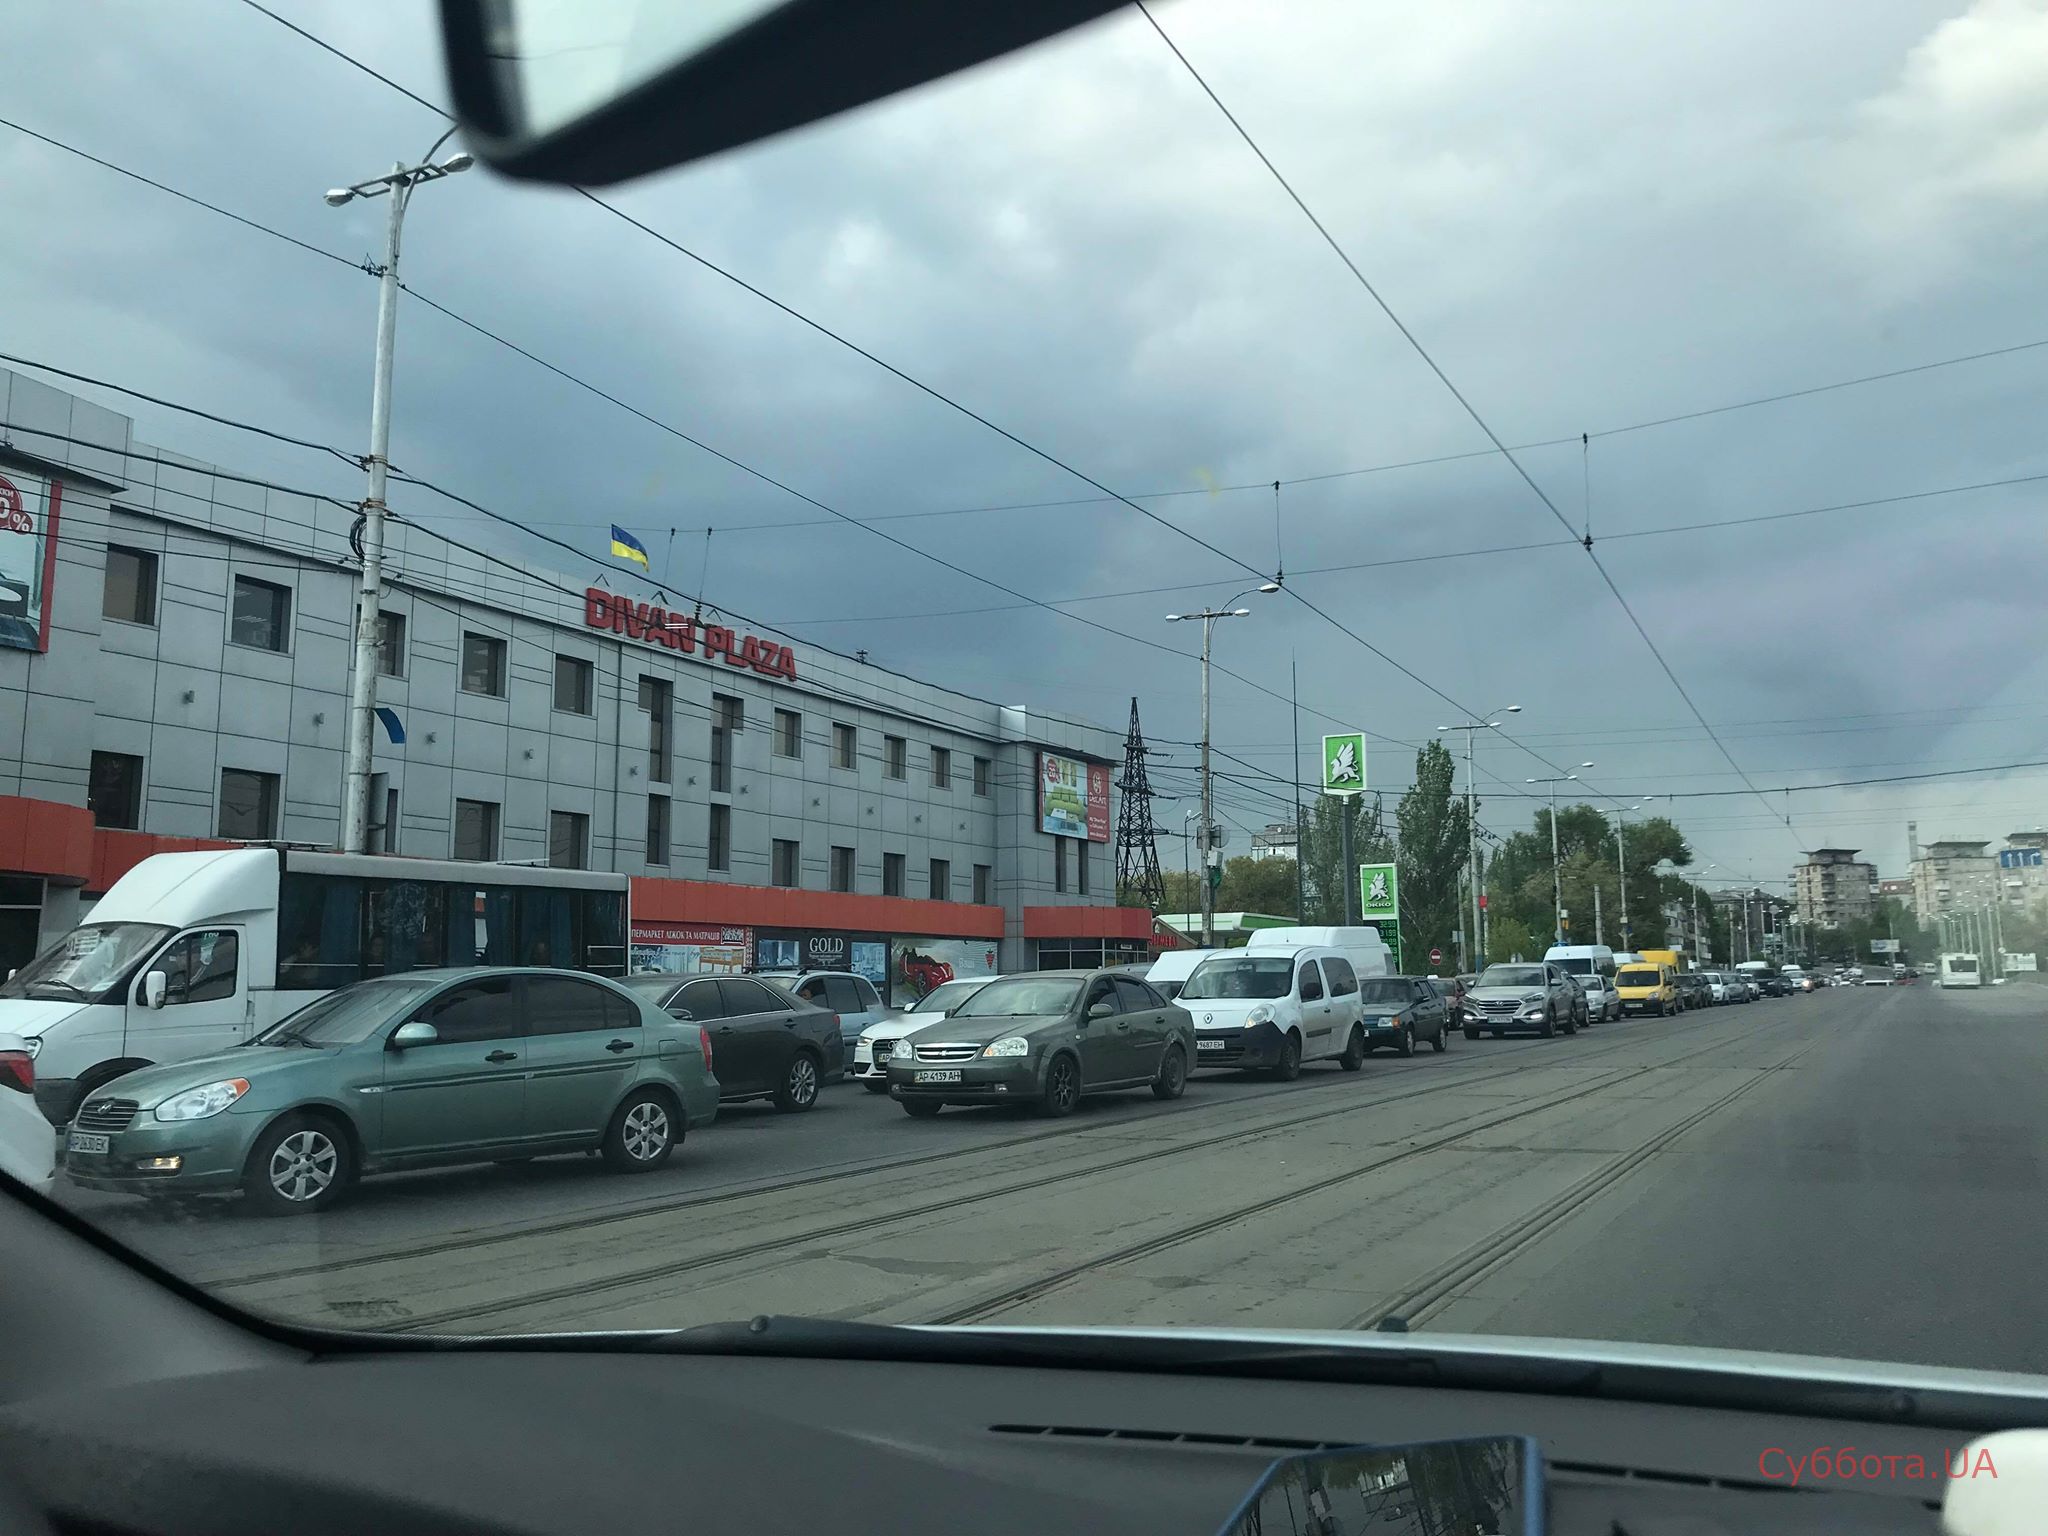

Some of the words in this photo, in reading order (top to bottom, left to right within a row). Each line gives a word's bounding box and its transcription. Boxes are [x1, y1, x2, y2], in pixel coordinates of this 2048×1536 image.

[586, 587, 696, 653] DIVAN
[705, 624, 798, 682] PLAZA
[809, 937, 844, 952] GOLD
